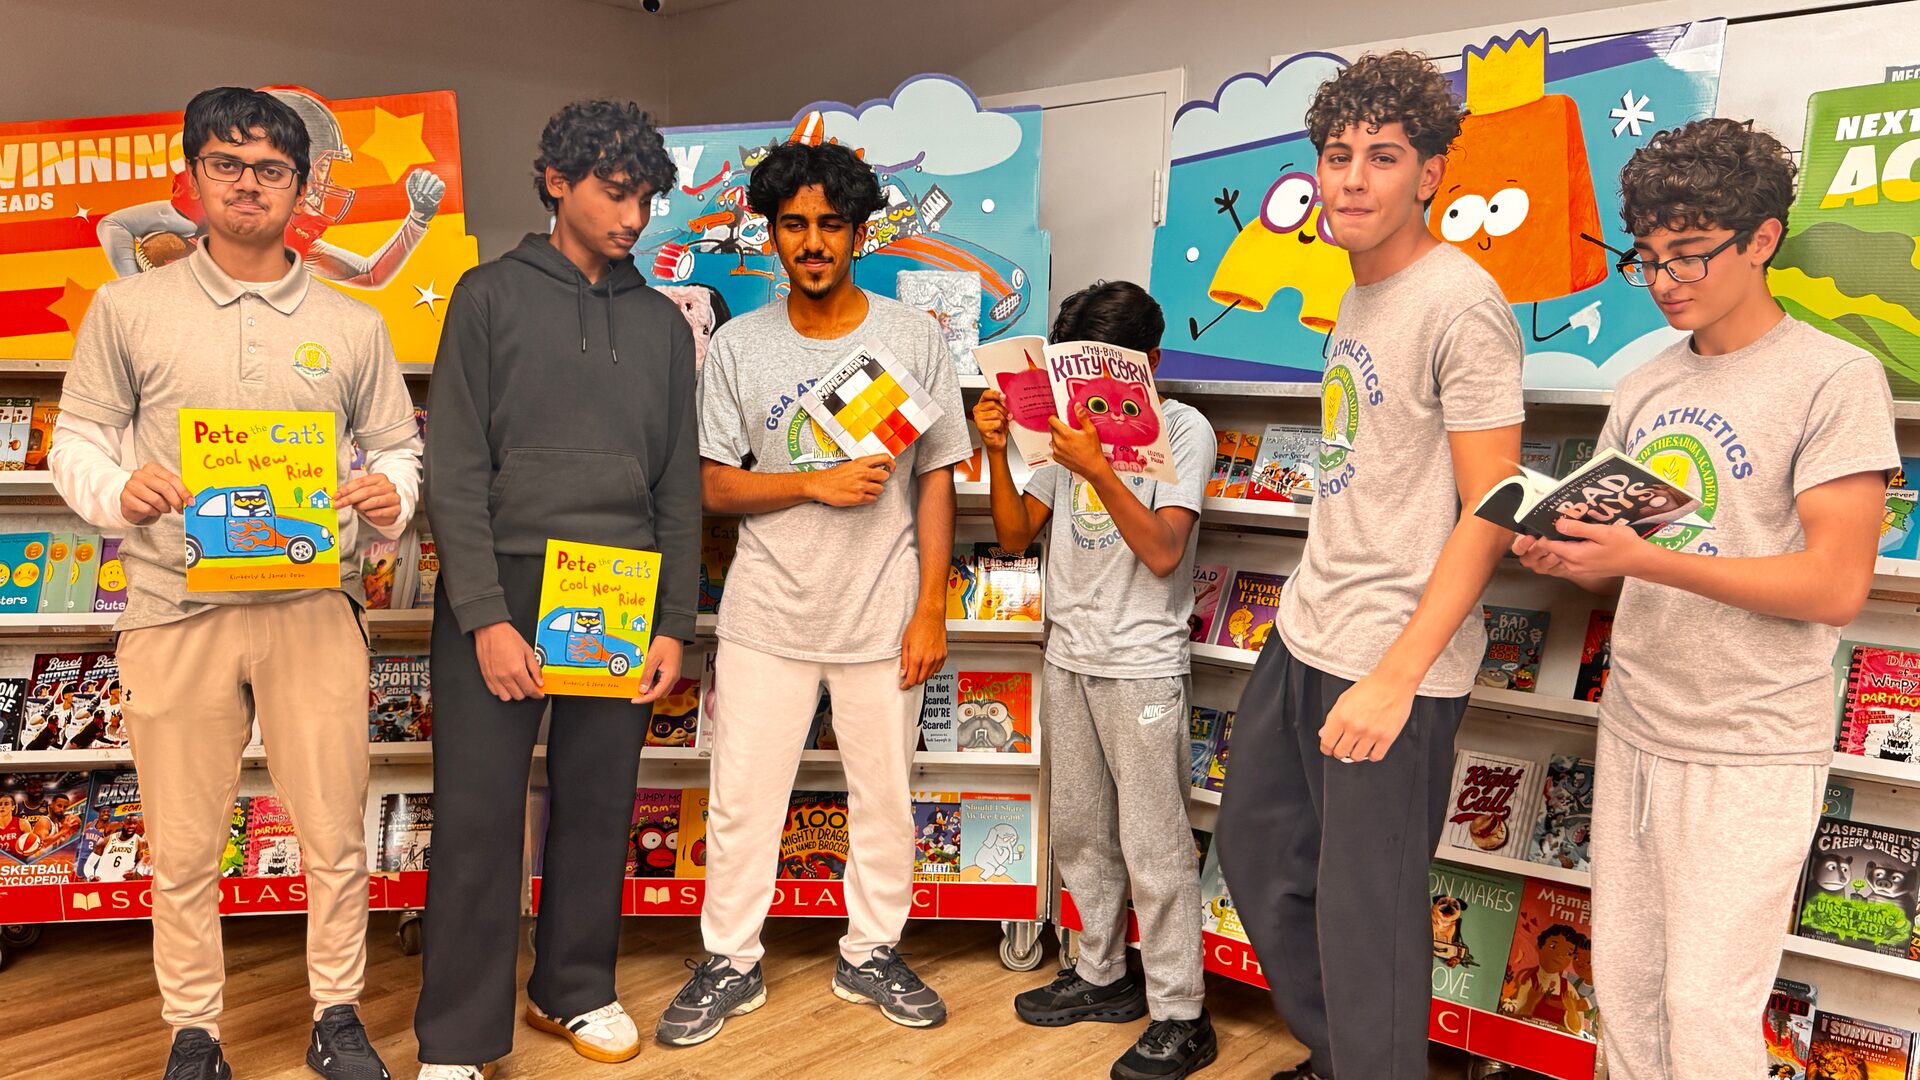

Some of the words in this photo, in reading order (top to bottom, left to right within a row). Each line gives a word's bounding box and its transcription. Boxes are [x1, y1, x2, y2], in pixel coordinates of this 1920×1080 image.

[816, 349, 874, 402] MINECRAFT
[1108, 357, 1151, 388] CORN
[1331, 339, 1384, 406] ATHLETICS
[766, 394, 794, 431] GSA
[797, 377, 823, 398] AT
[194, 421, 248, 444] Pete
[250, 425, 267, 435] the
[270, 423, 325, 444] Cat's
[1627, 427, 1647, 456] SA
[1652, 407, 1753, 480] ATHLETICS
[203, 449, 242, 469] Cool
[248, 454, 287, 472] New
[286, 462, 323, 481] Ride
[1556, 474, 1630, 519] BAD
[1588, 482, 1655, 520] UYS
[1099, 530, 1122, 549] 200
[557, 551, 596, 573] Pete
[599, 558, 611, 566] the
[612, 559, 651, 579] Cat's
[560, 576, 588, 592] Cool
[593, 582, 622, 597] New
[619, 592, 646, 606] Ride
[1238, 579, 1282, 598] Wrong
[1499, 614, 1528, 629] BAD
[1490, 627, 1529, 643] GUYS
[378, 662, 409, 672] YEAR
[411, 662, 425, 672] IN
[1488, 651, 1520, 663] BOOK
[369, 672, 431, 689] SPORTS
[386, 687, 411, 695] 2026
[936, 684, 950, 693] Not
[1870, 672, 1918, 694] Wimpy
[1143, 704, 1166, 718] NIKE
[923, 720, 951, 729] Scared!
[1464, 765, 1524, 795] Right
[95, 783, 140, 807] BASK
[1457, 786, 1515, 820] Call
[795, 810, 847, 830] 100
[781, 829, 816, 848] MIGHTY
[818, 828, 849, 844] DRAGO
[1820, 822, 1869, 837] JASPER
[1872, 830, 1920, 850] RABBIT'S
[785, 846, 795, 856] ALL
[796, 841, 817, 852] NAMED
[1818, 835, 1863, 851] CREEPY
[1875, 840, 1919, 867] TALES!
[924, 864, 949, 872] MEET
[1459, 881, 1516, 913] MAKES
[1550, 906, 1575, 922] I'm
[1817, 901, 1896, 926] UNSETTLING
[1828, 915, 1884, 937] SALAD!
[1829, 1020, 1903, 1049] SURVIVED
